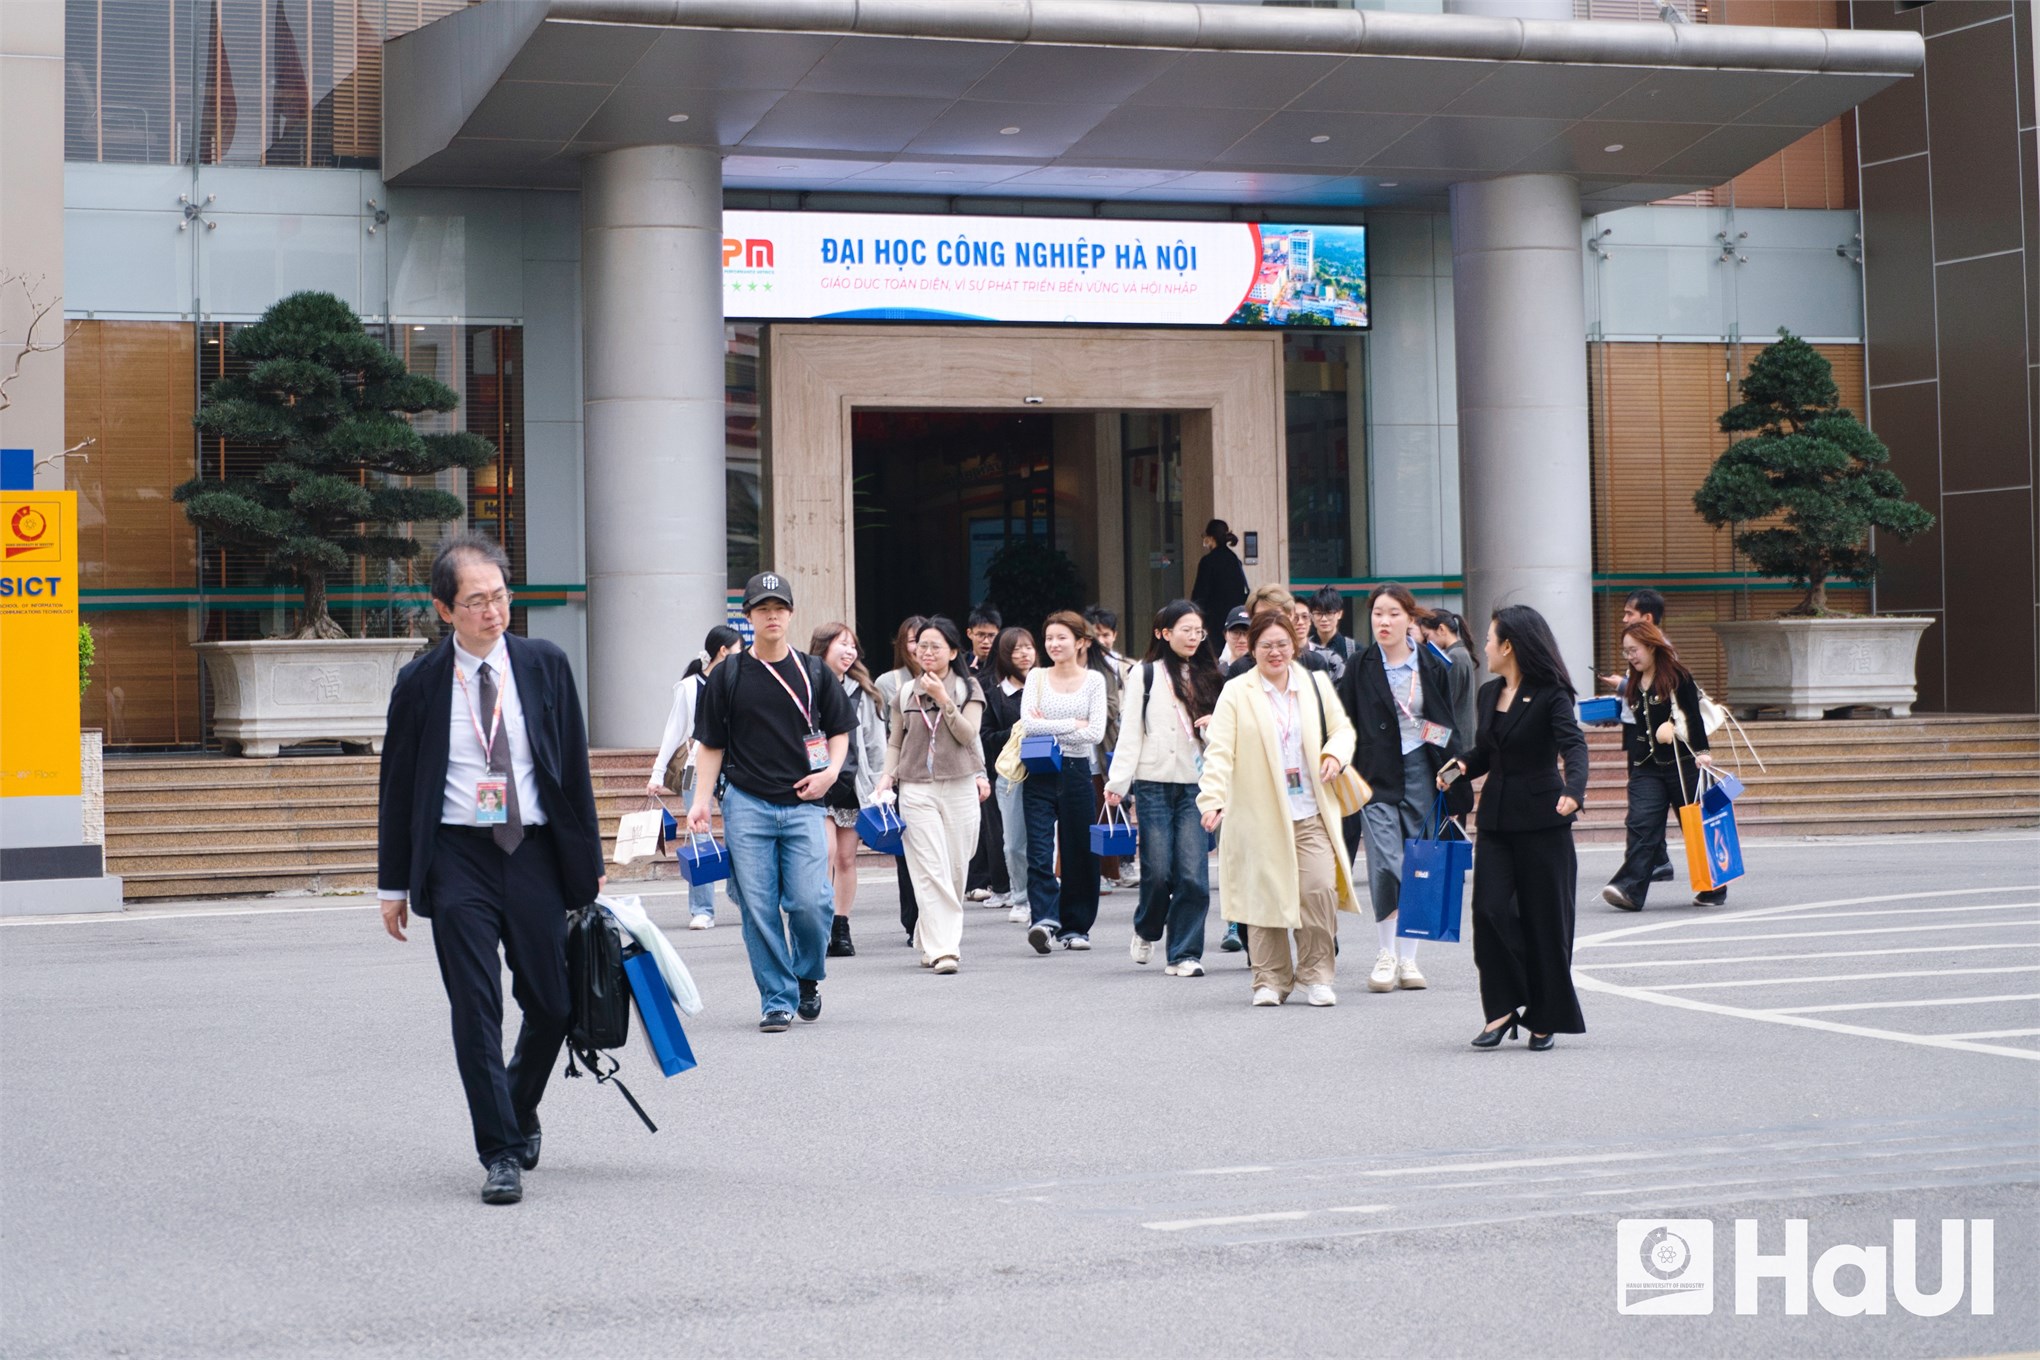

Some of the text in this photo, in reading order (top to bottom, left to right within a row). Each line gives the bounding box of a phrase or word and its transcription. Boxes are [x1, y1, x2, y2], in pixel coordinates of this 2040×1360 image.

[821, 234, 1197, 277] ĐẠI HỌC CÔNG NGHIỆP HÀ NỘI
[820, 275, 851, 289] GIÁO
[988, 277, 1019, 291] PHÁT
[0, 576, 62, 597] SICT
[311, 667, 343, 702] 福
